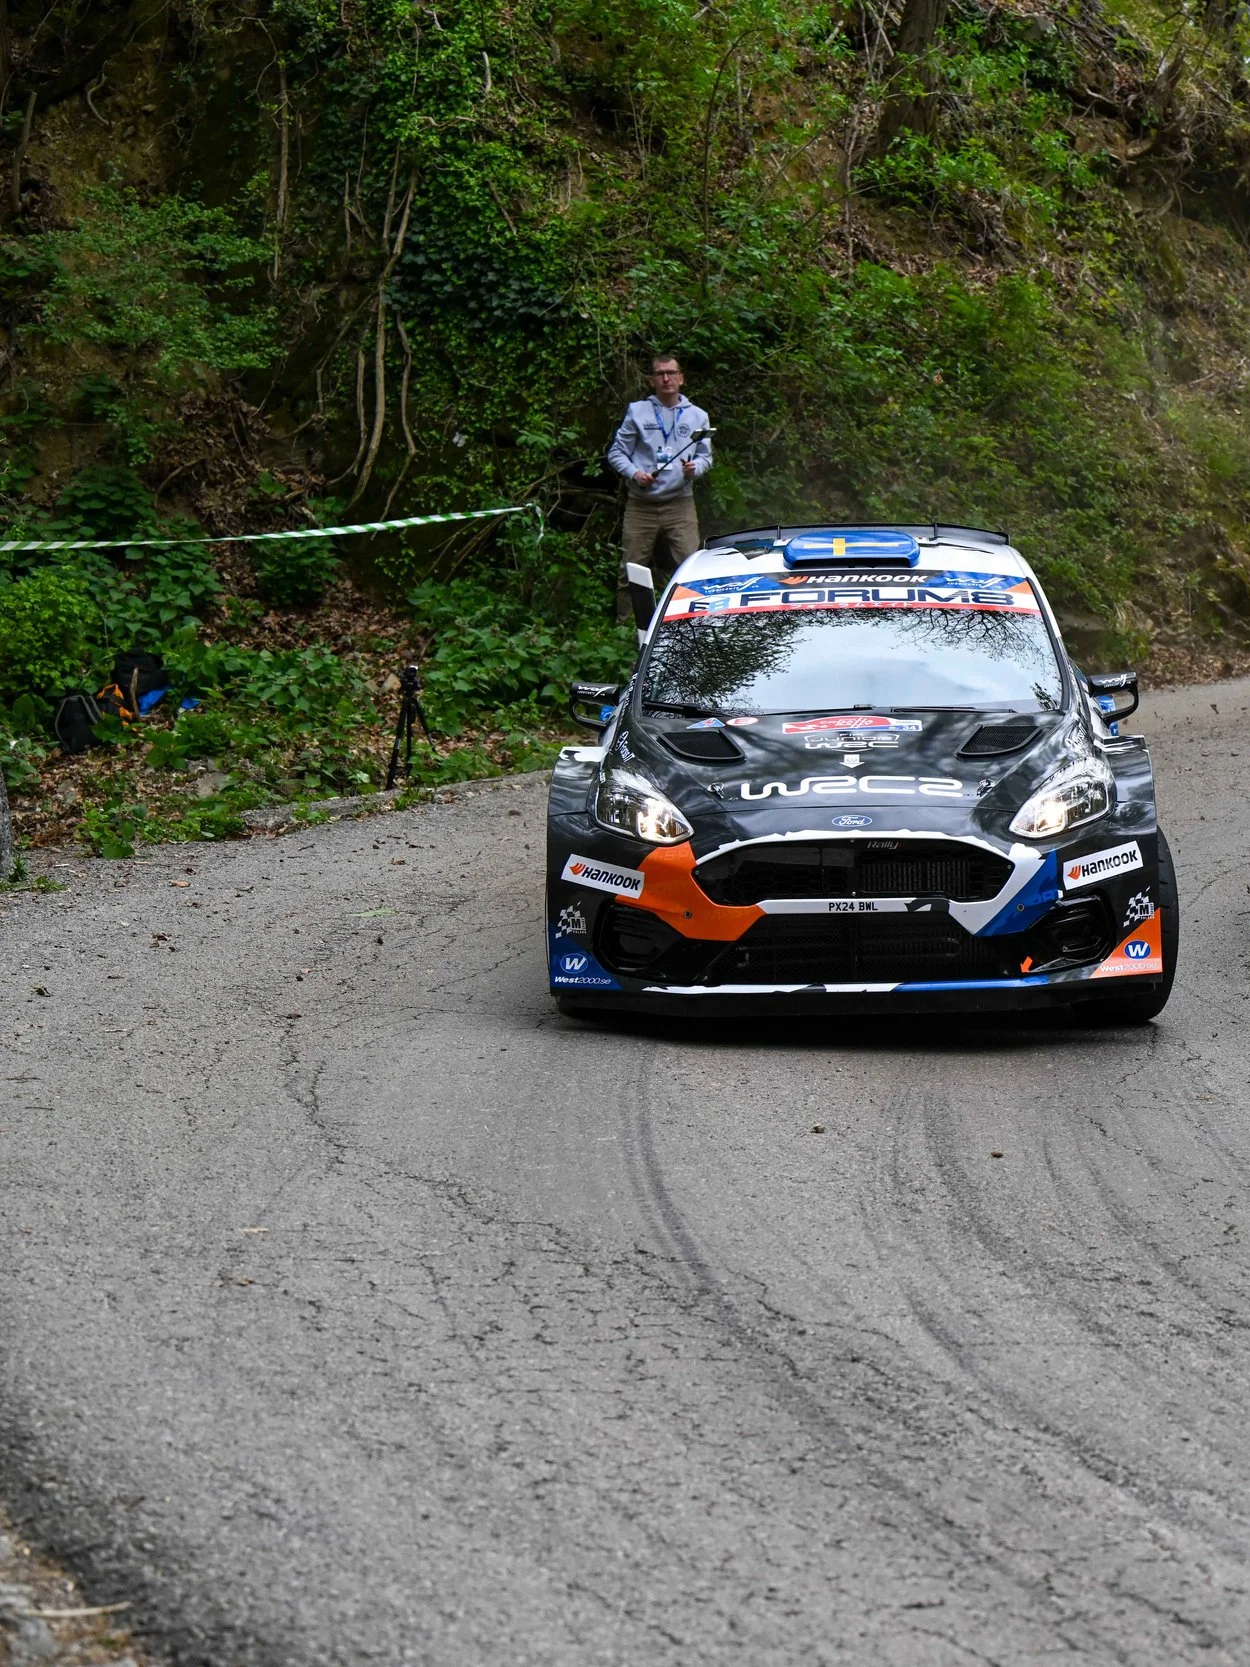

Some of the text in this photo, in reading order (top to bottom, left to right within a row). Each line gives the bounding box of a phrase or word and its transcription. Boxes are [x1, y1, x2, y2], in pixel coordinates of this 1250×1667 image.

[740, 588, 1015, 606] FORUM8
[741, 775, 963, 800] WRC2
[838, 815, 866, 827] Ford
[1081, 850, 1138, 877] HANKOOK
[582, 868, 641, 891] HANKOOK
[828, 902, 878, 911] PX24 BWL
[554, 976, 612, 985] West2000.se
